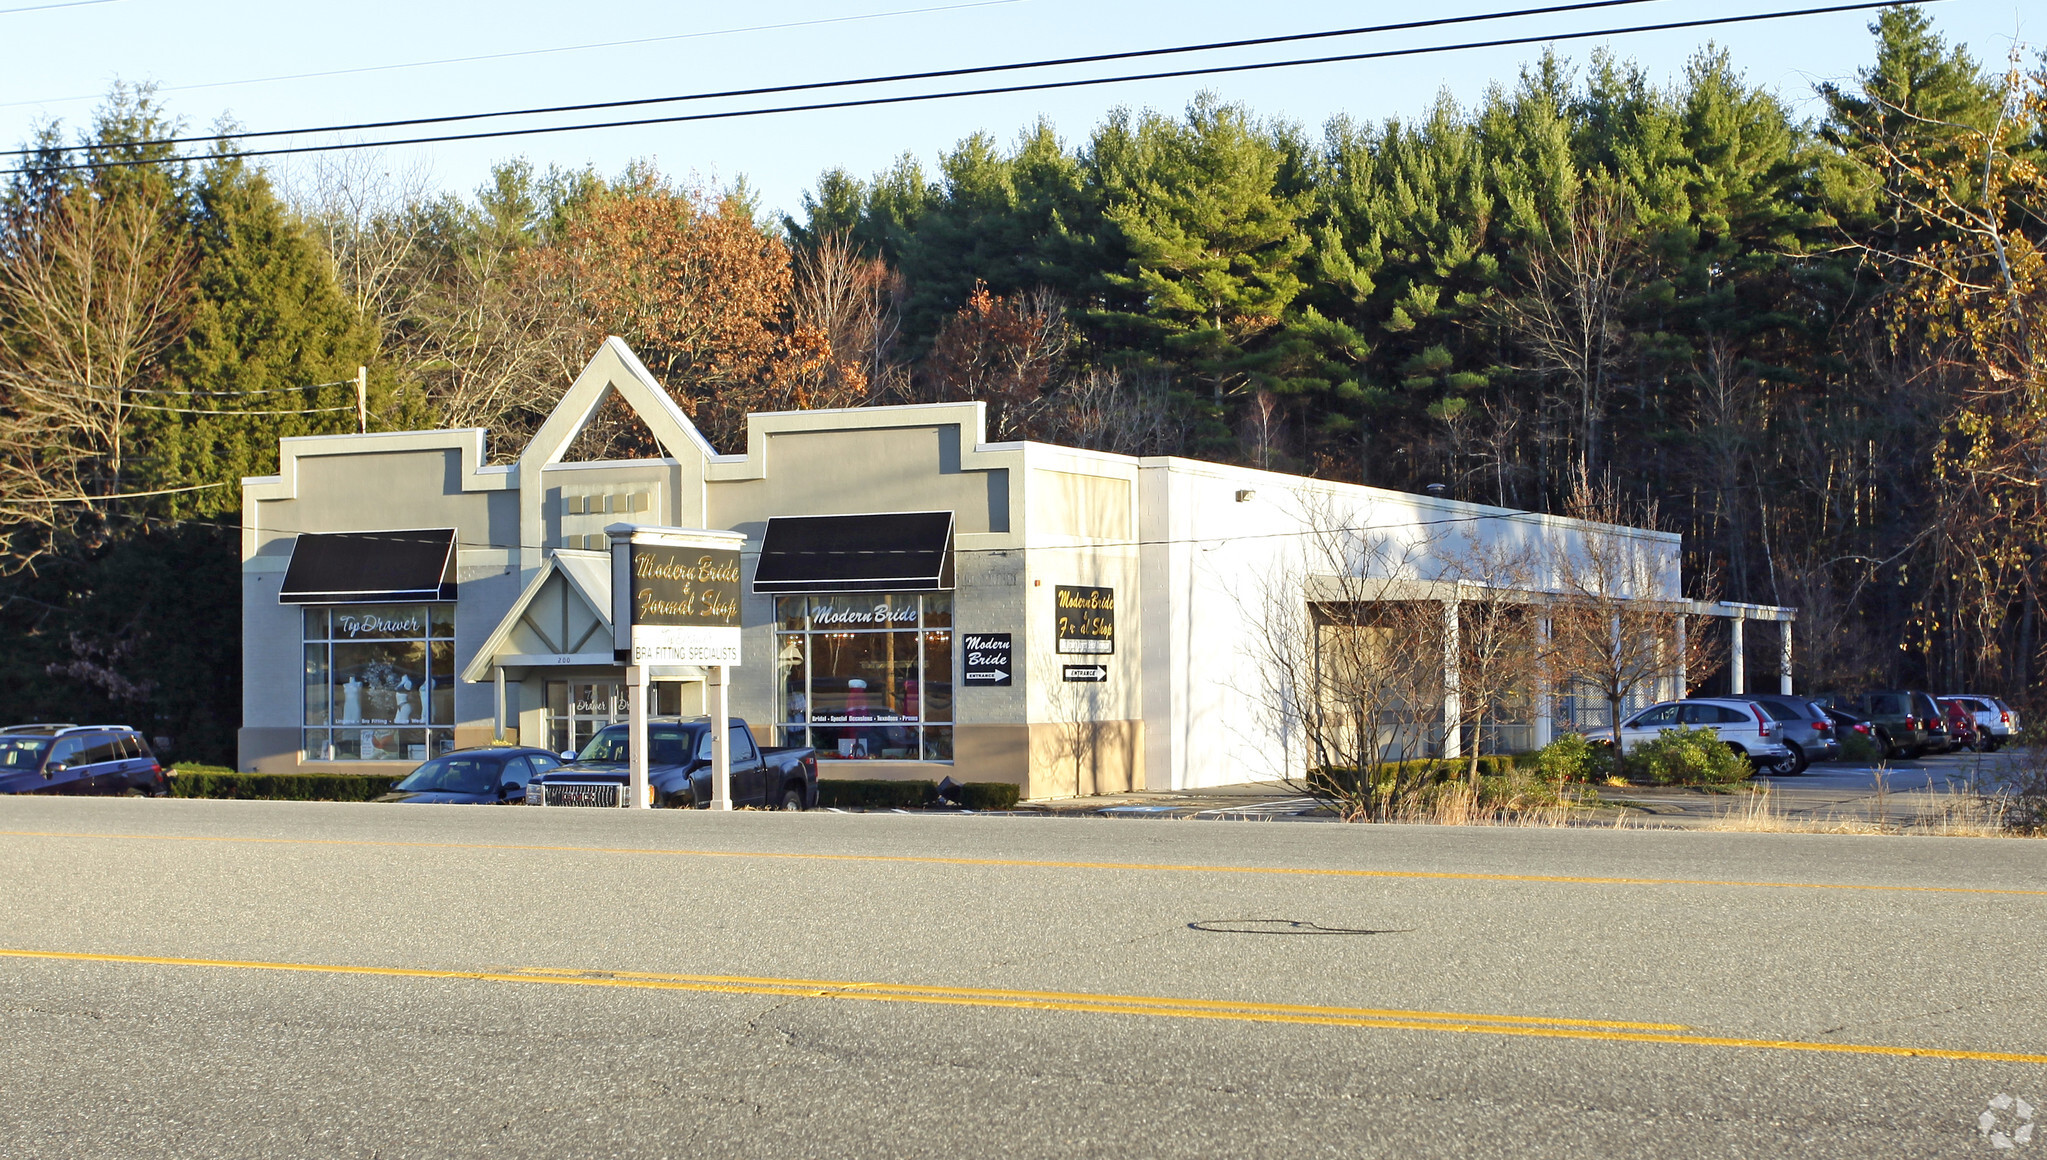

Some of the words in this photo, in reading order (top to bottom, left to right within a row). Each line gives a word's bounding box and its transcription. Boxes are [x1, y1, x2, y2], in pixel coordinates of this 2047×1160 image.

[634, 552, 697, 581] Modern
[697, 555, 740, 583] Bride
[683, 581, 691, 595] &
[637, 588, 695, 620] Formal
[700, 589, 738, 623] Shop
[1058, 590, 1090, 609] Modern
[1091, 590, 1114, 610] Bride
[812, 605, 873, 624] Modern
[873, 604, 917, 623] Bride
[340, 615, 361, 638] Top
[361, 615, 420, 632] Drawer
[1059, 617, 1091, 638] Fral
[1092, 617, 1113, 640] Shop
[635, 646, 652, 660] BRA
[656, 647, 686, 660] FITTING
[689, 647, 737, 660] SPECIALISTS
[965, 636, 1010, 650] Modern
[968, 652, 1008, 666] Bride
[562, 793, 593, 801] GMC
